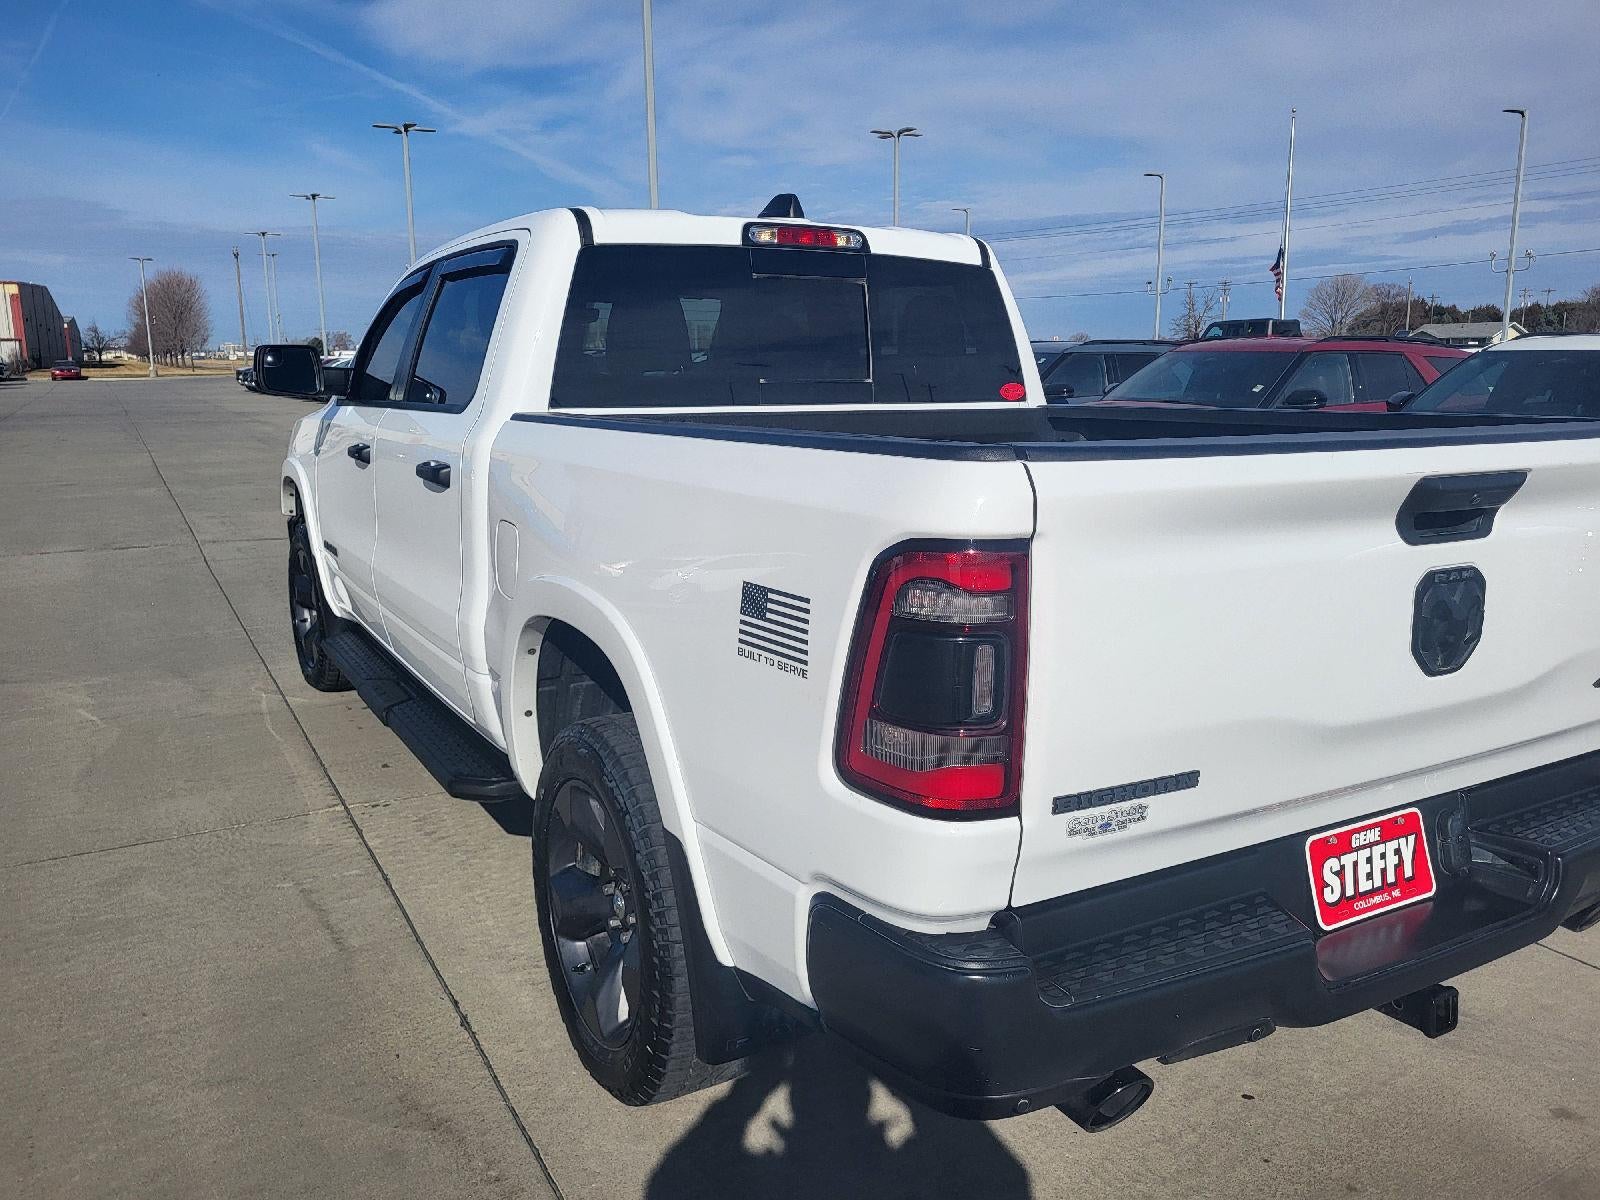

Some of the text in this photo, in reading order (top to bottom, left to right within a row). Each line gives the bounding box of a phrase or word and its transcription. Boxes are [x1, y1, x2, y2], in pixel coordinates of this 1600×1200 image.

[737, 646, 809, 680] BUILT TO SERVE
[1351, 827, 1381, 848] GENE
[1322, 833, 1416, 905] STEFFY
[1353, 888, 1402, 911] COLUMBUS, NE
